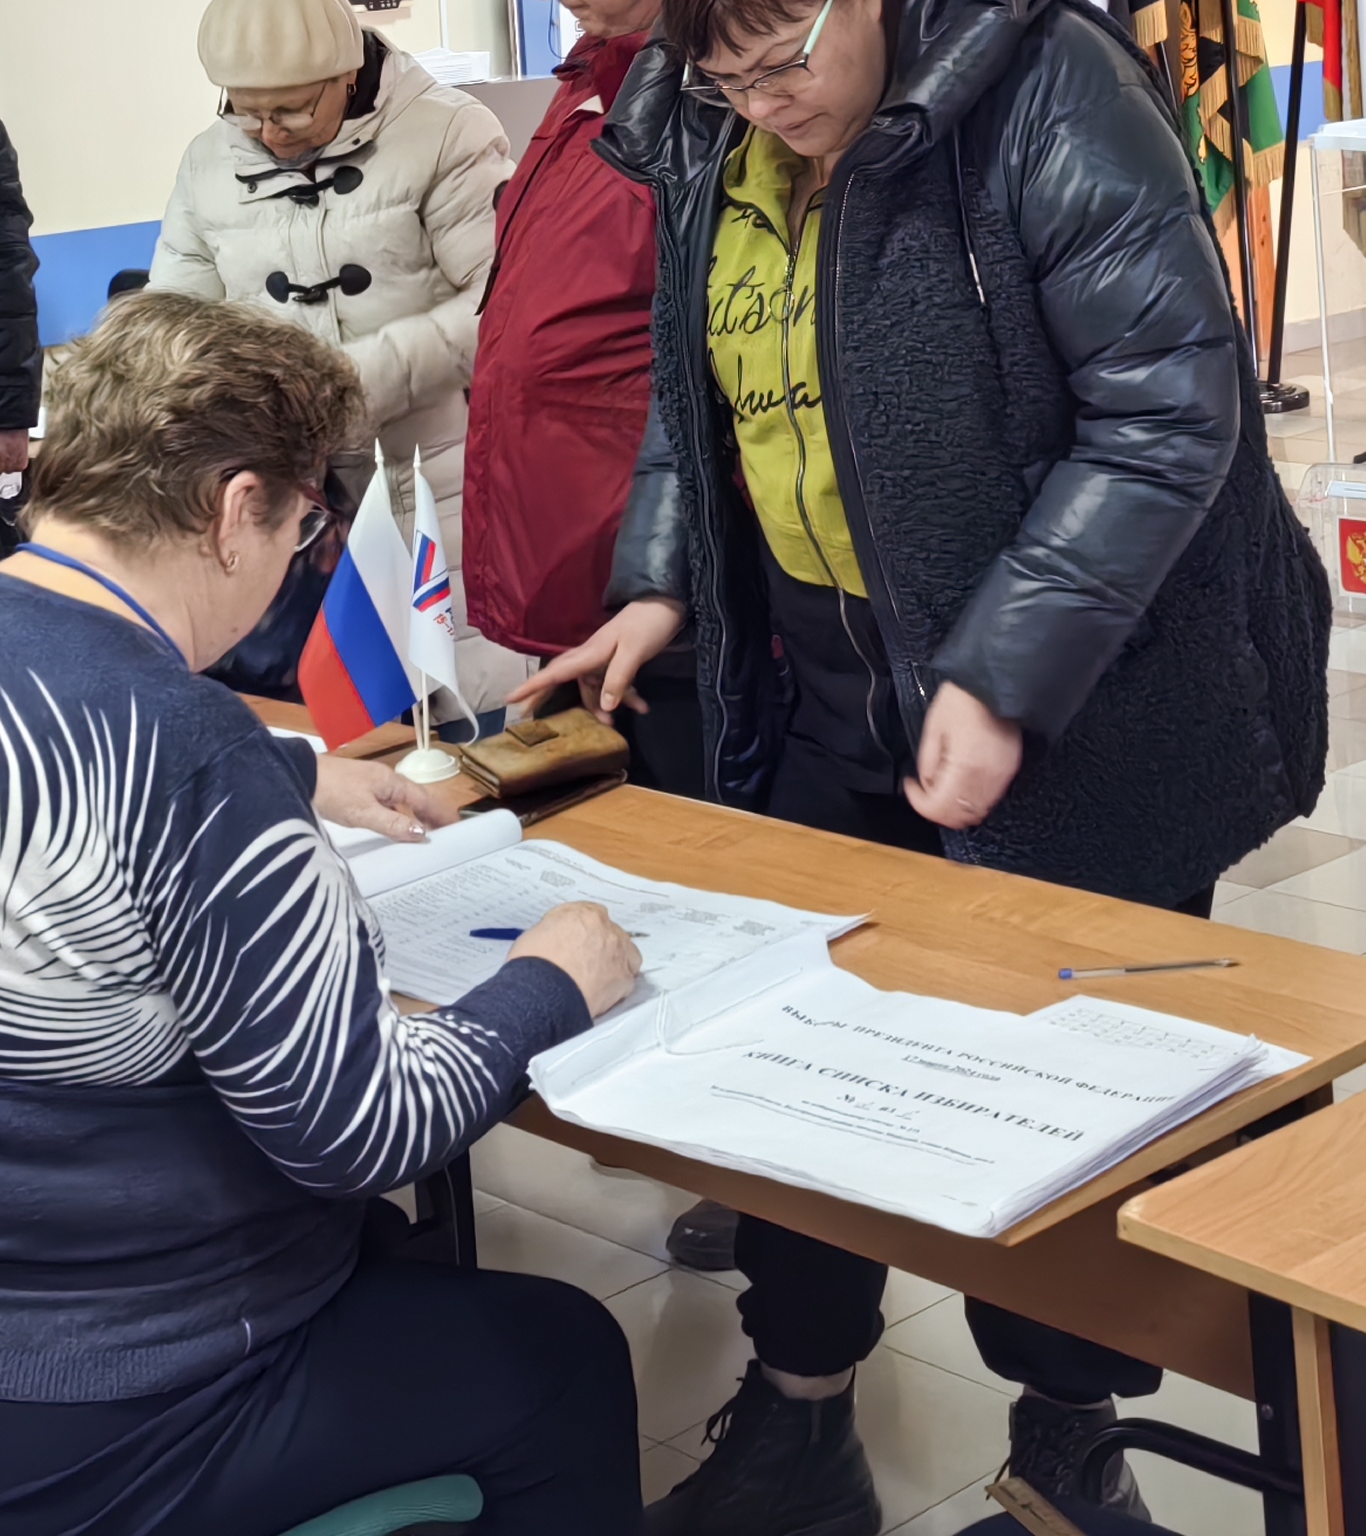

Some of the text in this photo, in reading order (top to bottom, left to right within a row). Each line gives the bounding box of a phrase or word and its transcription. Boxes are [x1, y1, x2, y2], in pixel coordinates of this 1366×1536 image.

[742, 1051, 813, 1071] КНИГА
[818, 1067, 909, 1097] СПИСКА
[913, 1091, 1085, 1142] ИЗБИРАТЕЛЕЙ
[957, 1052, 1073, 1085] РОССИЙСКОЙ
